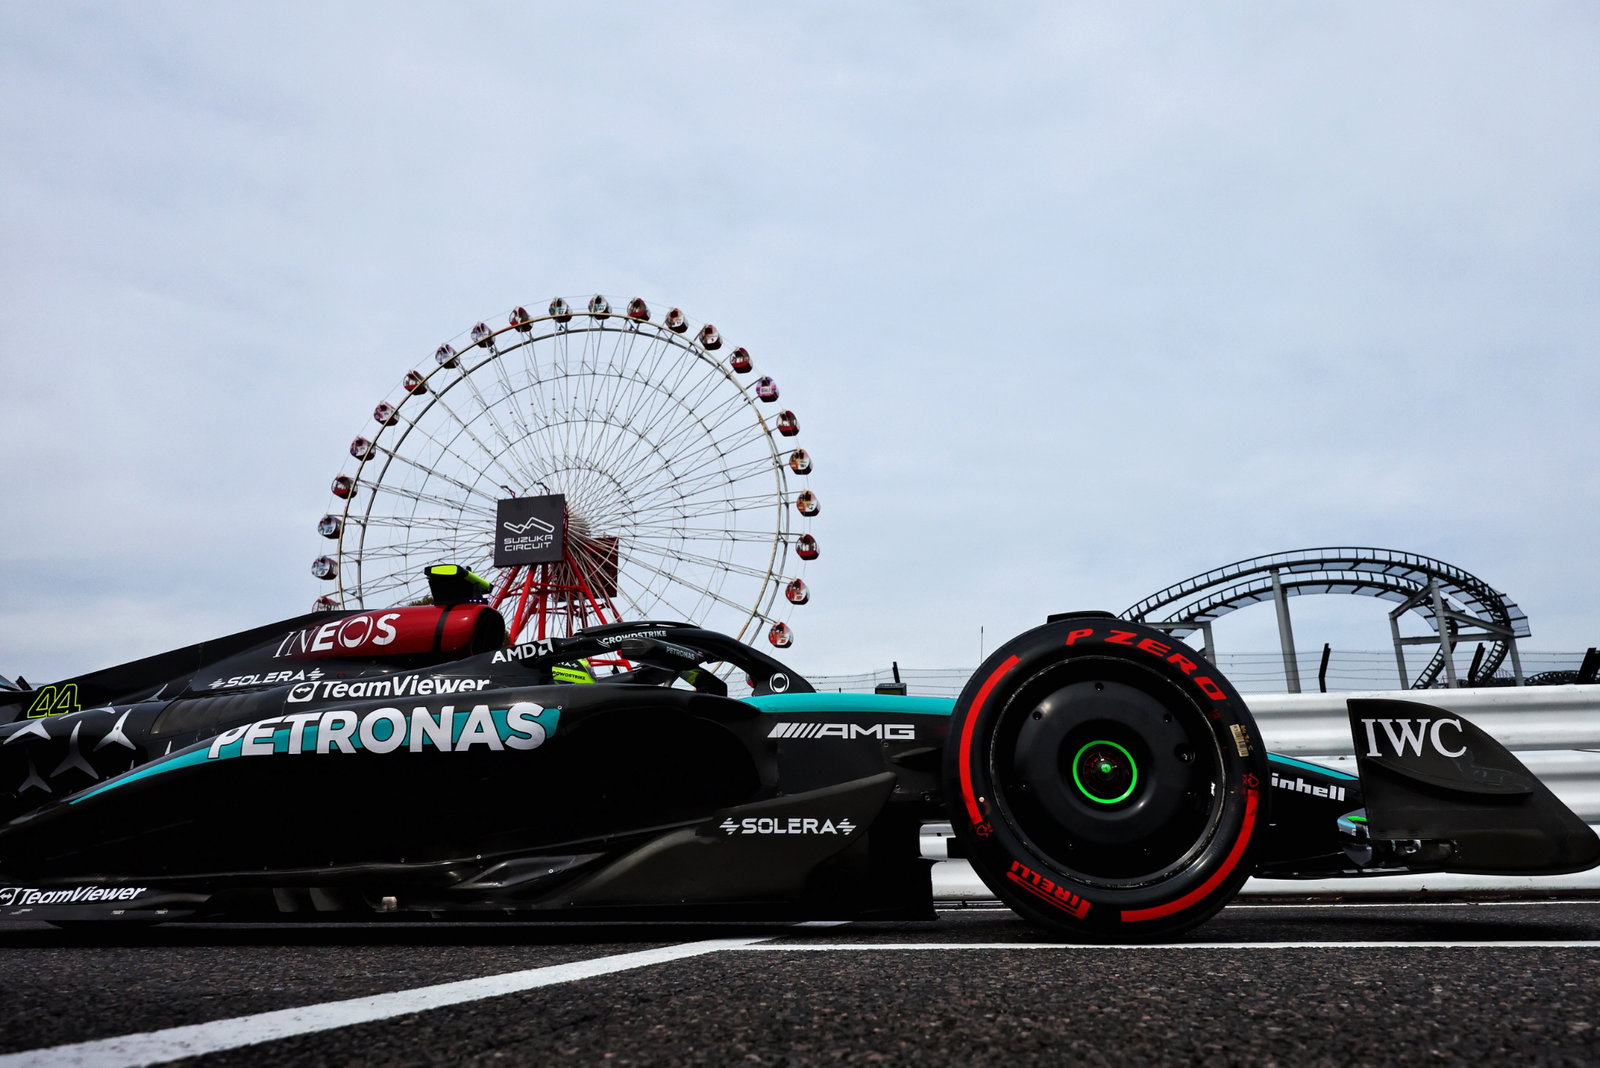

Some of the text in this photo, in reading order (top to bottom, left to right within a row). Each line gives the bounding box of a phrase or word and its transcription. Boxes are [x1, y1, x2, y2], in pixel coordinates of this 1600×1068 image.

[503, 534, 553, 545] SUZUKA
[504, 541, 552, 552] CIRCUIT
[272, 613, 401, 659] INEOS
[491, 643, 537, 664] AMD
[666, 646, 695, 660] PETRONAS
[1065, 628, 1227, 701] P ZERO
[223, 669, 305, 688] SOLERA
[322, 674, 490, 698] TeamViewer
[27, 683, 81, 719] 44
[207, 701, 547, 759] PETRONAS
[815, 723, 915, 739] AMG
[1360, 718, 1467, 758] IWC
[1271, 772, 1345, 802] inhell
[741, 817, 838, 835] SOLERA
[18, 885, 147, 905] TeamViewer
[1006, 860, 1092, 920] PIRELLI
